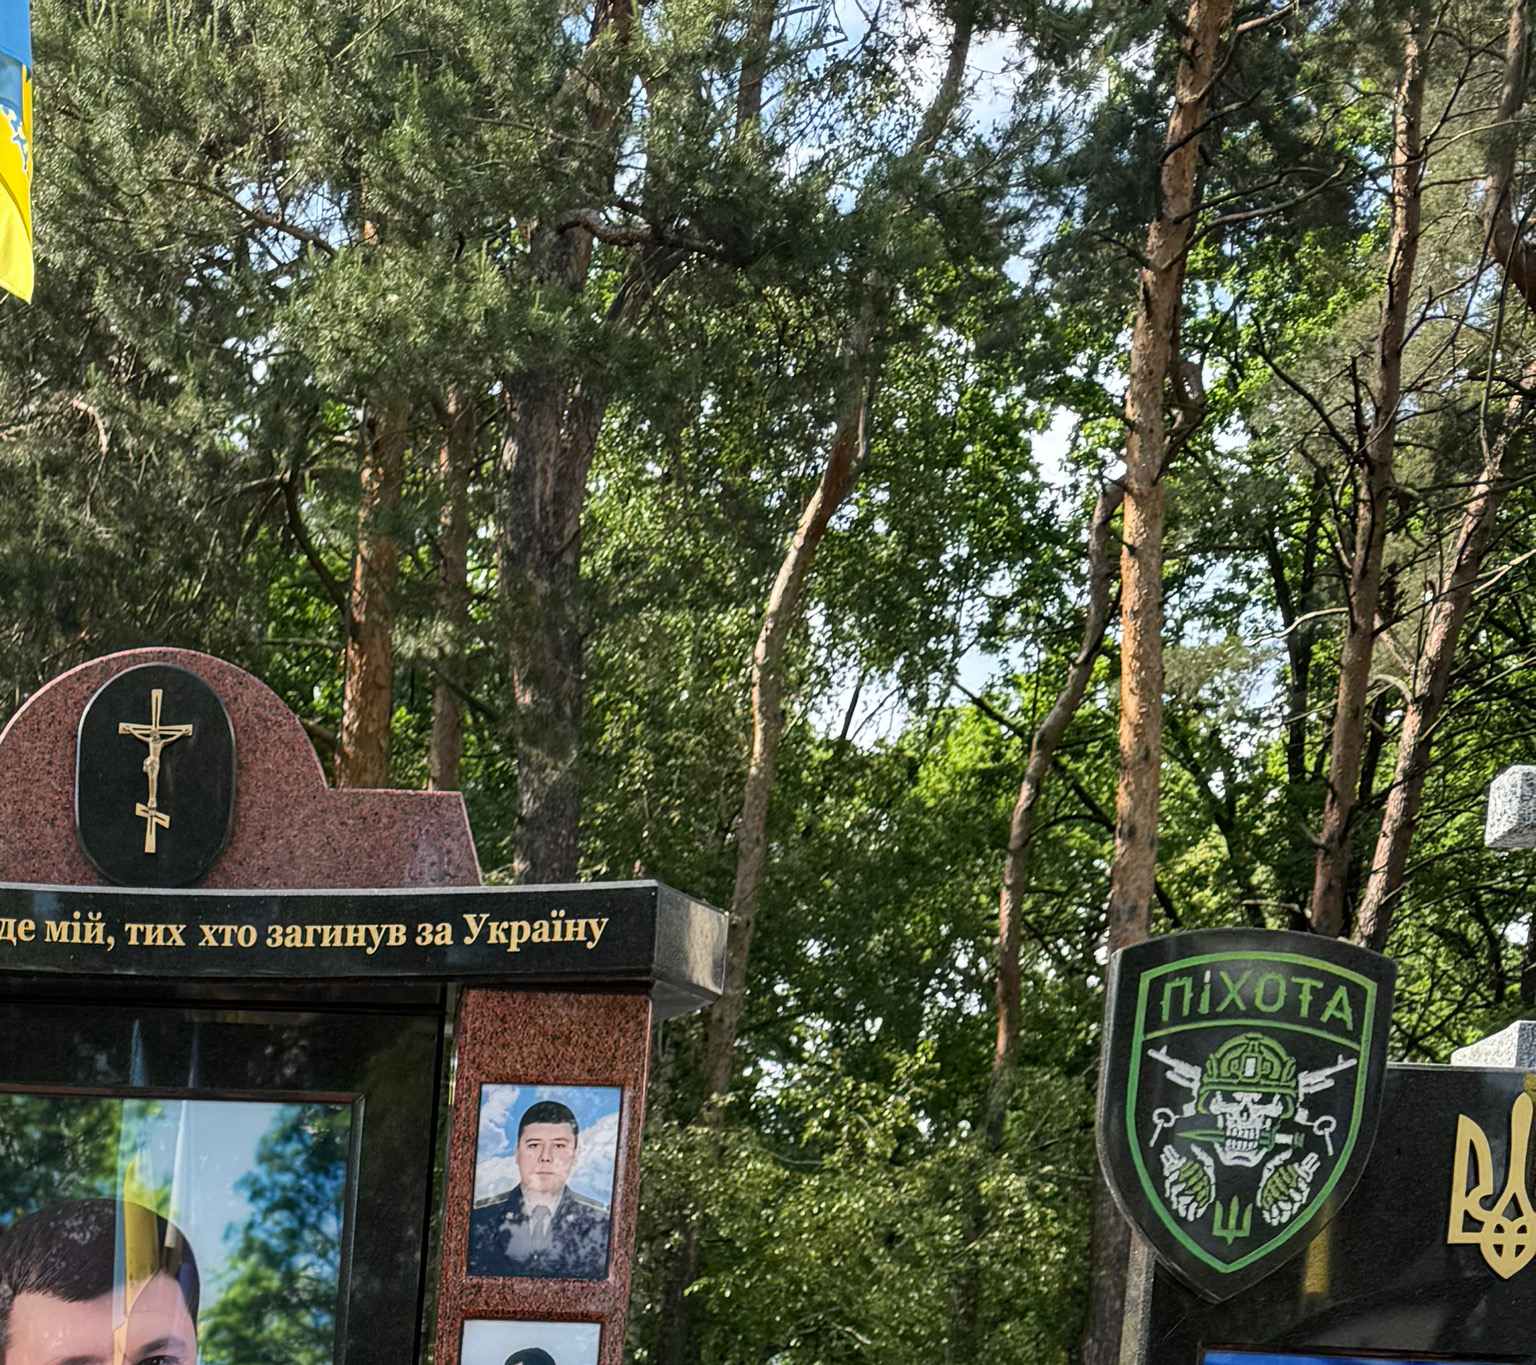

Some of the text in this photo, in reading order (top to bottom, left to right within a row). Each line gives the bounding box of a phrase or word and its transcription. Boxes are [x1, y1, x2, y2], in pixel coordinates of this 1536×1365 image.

[44, 911, 116, 952] мій,
[125, 922, 186, 947] тих
[197, 923, 257, 948] хто
[265, 922, 407, 955] загинув
[415, 922, 453, 947] за
[463, 909, 609, 953] Україну
[1160, 968, 1354, 1032] ПІХОТА
